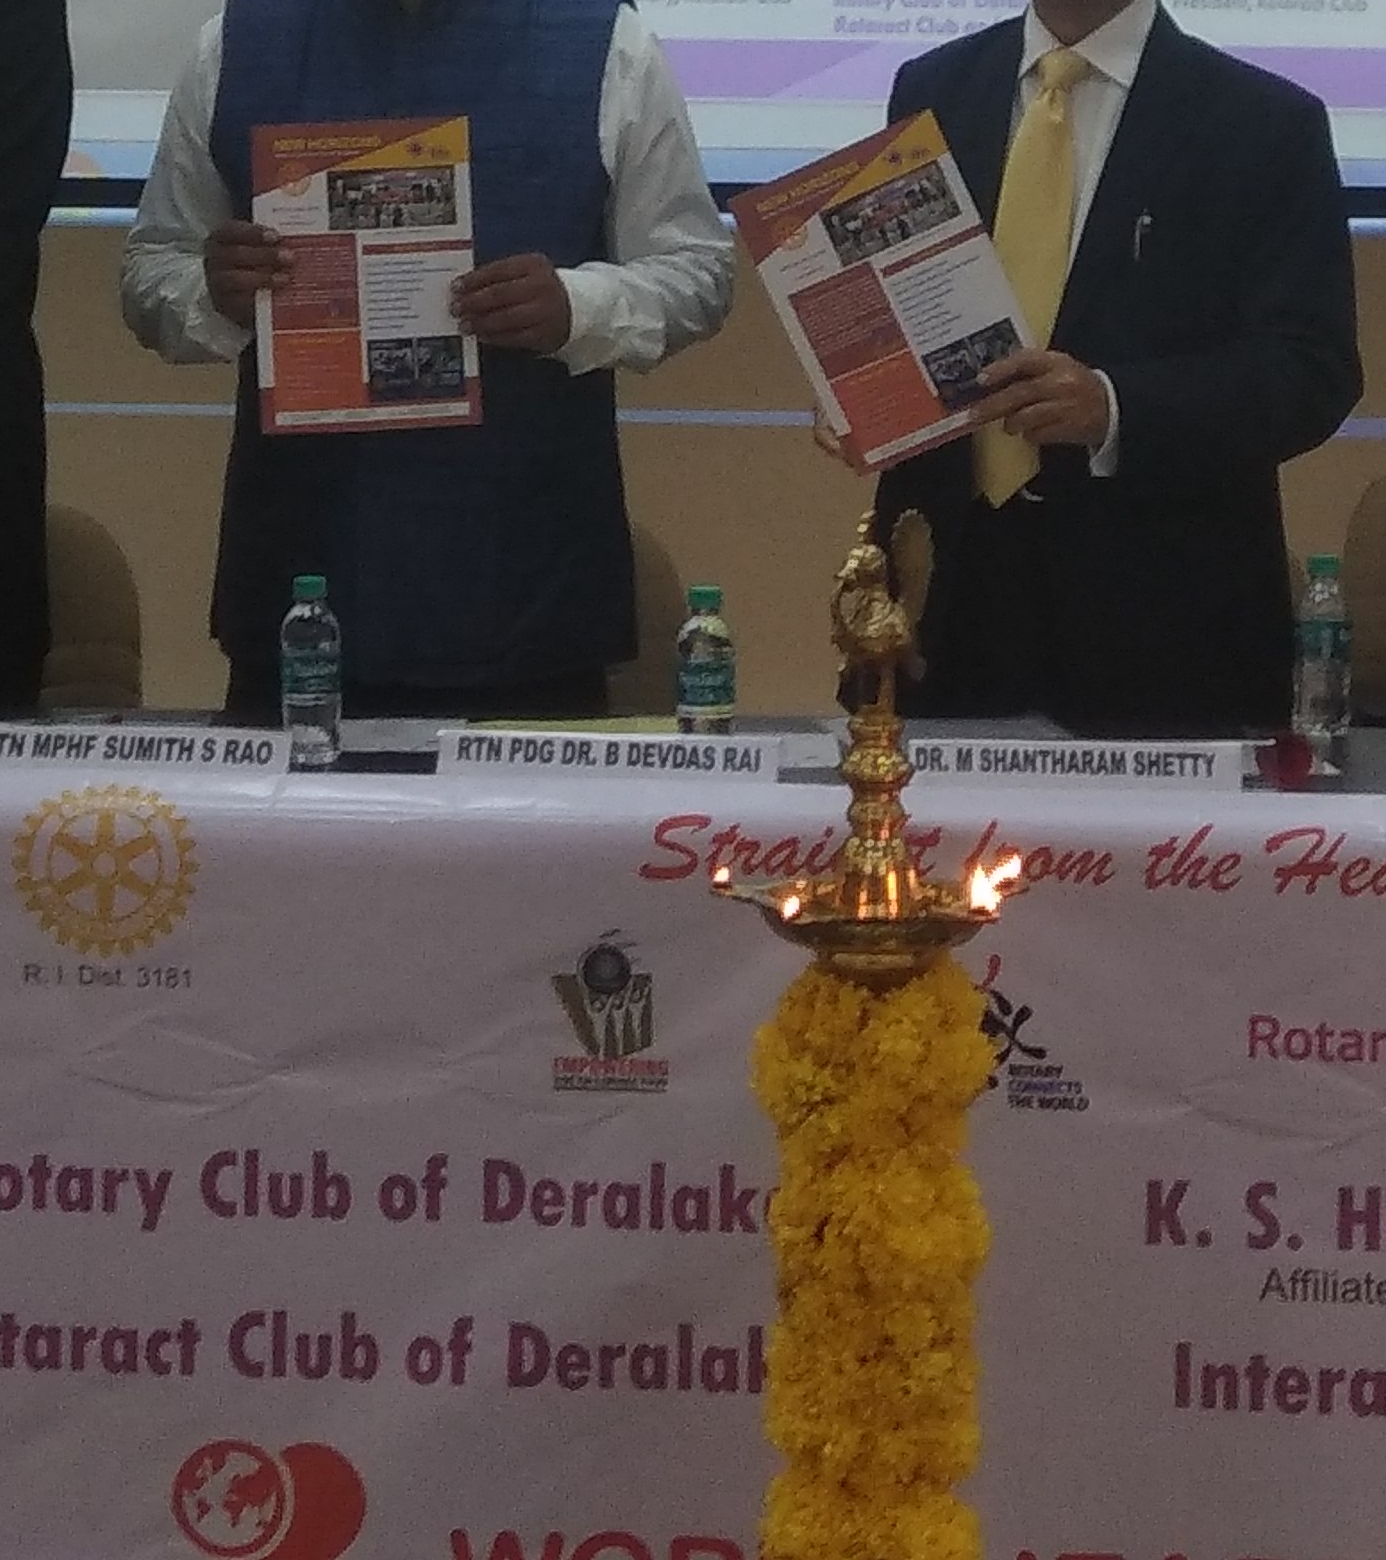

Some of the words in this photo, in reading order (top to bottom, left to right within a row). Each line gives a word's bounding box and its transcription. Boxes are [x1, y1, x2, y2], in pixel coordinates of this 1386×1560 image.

[31, 732, 98, 759] MPHF
[102, 735, 195, 761] SUMITH
[201, 737, 217, 762] S
[222, 738, 273, 765] RAO
[455, 736, 504, 762] RTN
[509, 738, 556, 765] PDG
[561, 740, 600, 767] DR.
[606, 742, 621, 768] B
[627, 743, 717, 771] DEVDAS
[722, 746, 762, 773] RAI
[914, 746, 951, 773] DR.
[956, 748, 974, 774] M
[979, 749, 1127, 776] SHANTHARAM
[1133, 751, 1216, 777] SHETTY
[638, 813, 942, 880] Strait
[963, 818, 1116, 886] fom
[1145, 824, 1243, 891] the
[136, 966, 192, 989] 3181
[200, 1148, 353, 1223] Club
[378, 1151, 451, 1224] of
[482, 1157, 778, 1234] Deralak
[1144, 1178, 1211, 1249] K.
[1244, 1180, 1303, 1252] S.
[227, 1309, 381, 1382] Club
[406, 1315, 475, 1386] of
[505, 1320, 768, 1394] Derala
